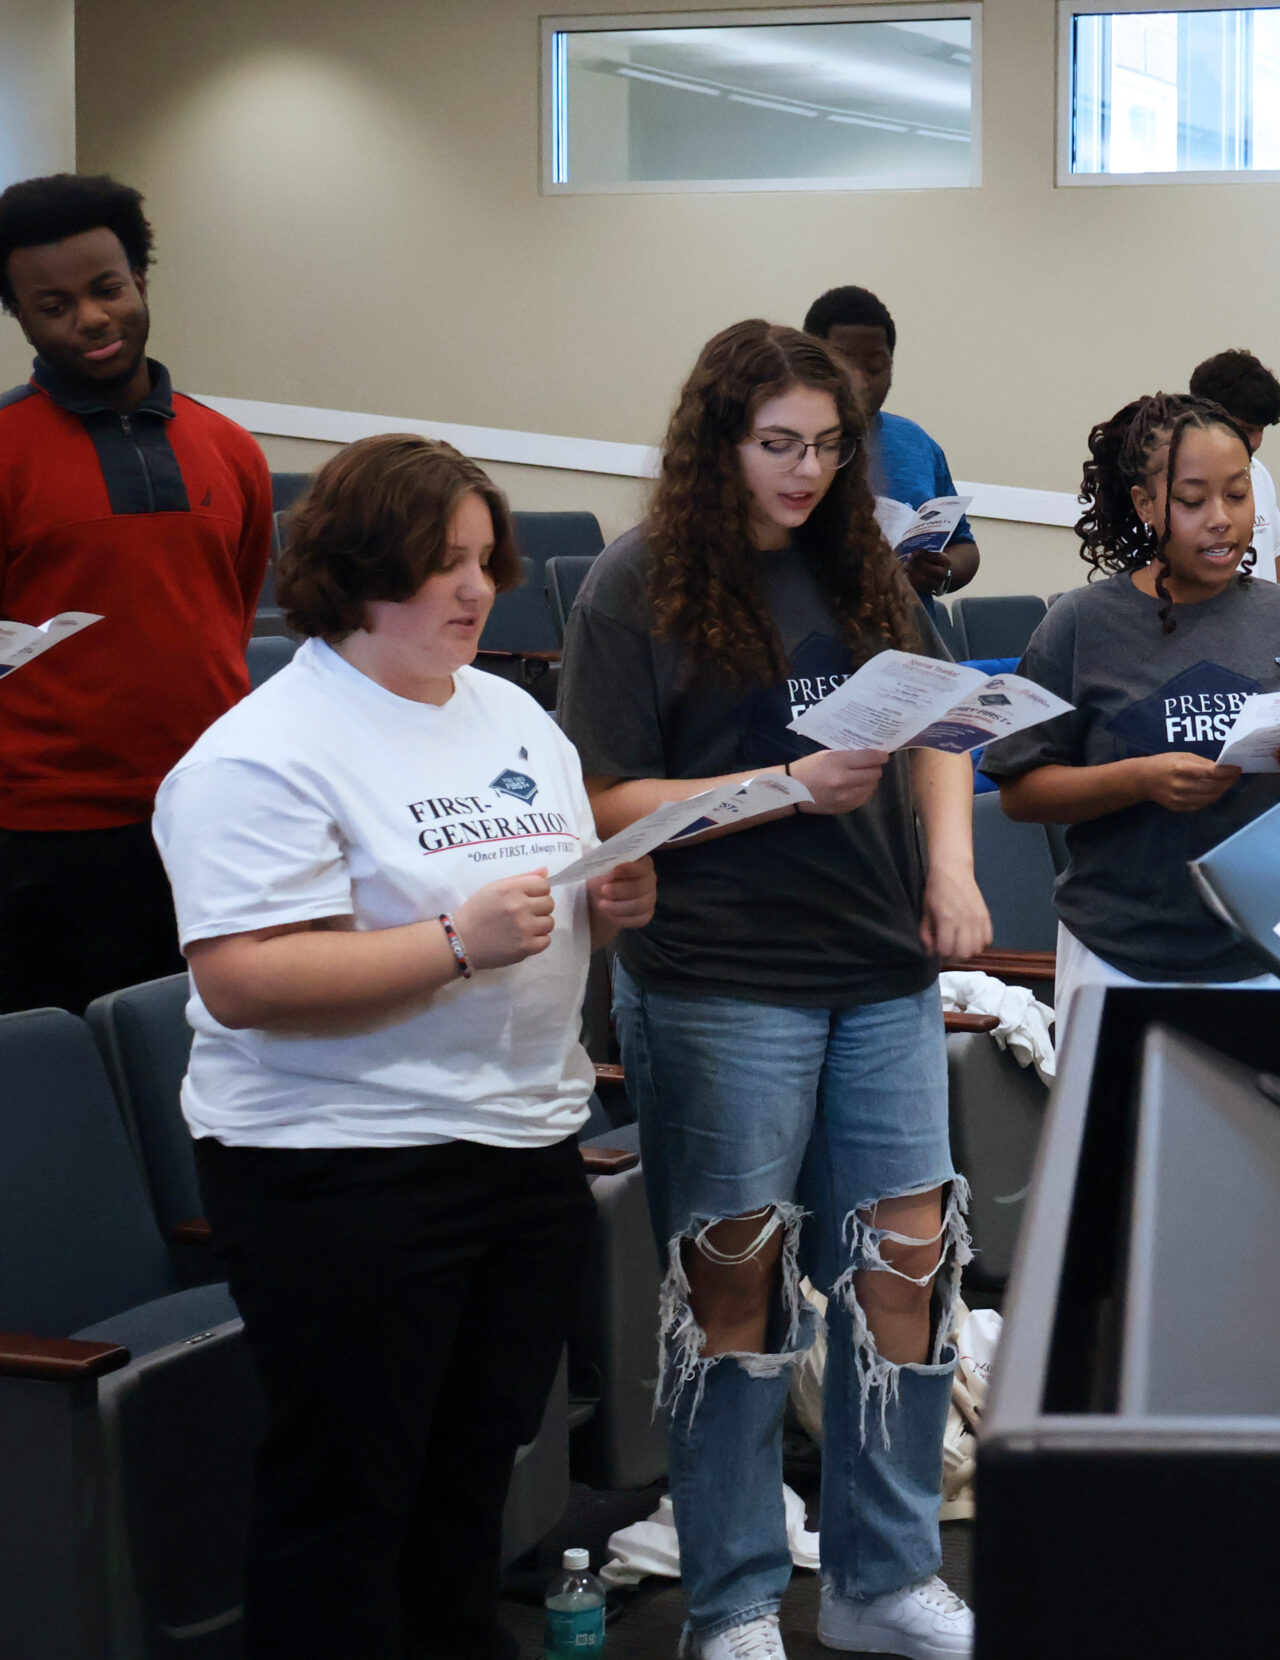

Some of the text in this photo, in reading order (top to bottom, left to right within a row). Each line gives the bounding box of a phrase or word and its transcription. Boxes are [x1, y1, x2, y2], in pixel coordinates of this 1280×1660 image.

[786, 673, 852, 703] PRES
[1163, 691, 1259, 717] PRESB
[407, 795, 493, 824] FIRST-
[418, 812, 570, 851] GENERATION
[499, 844, 529, 859] FIRST,
[530, 842, 556, 855] Always
